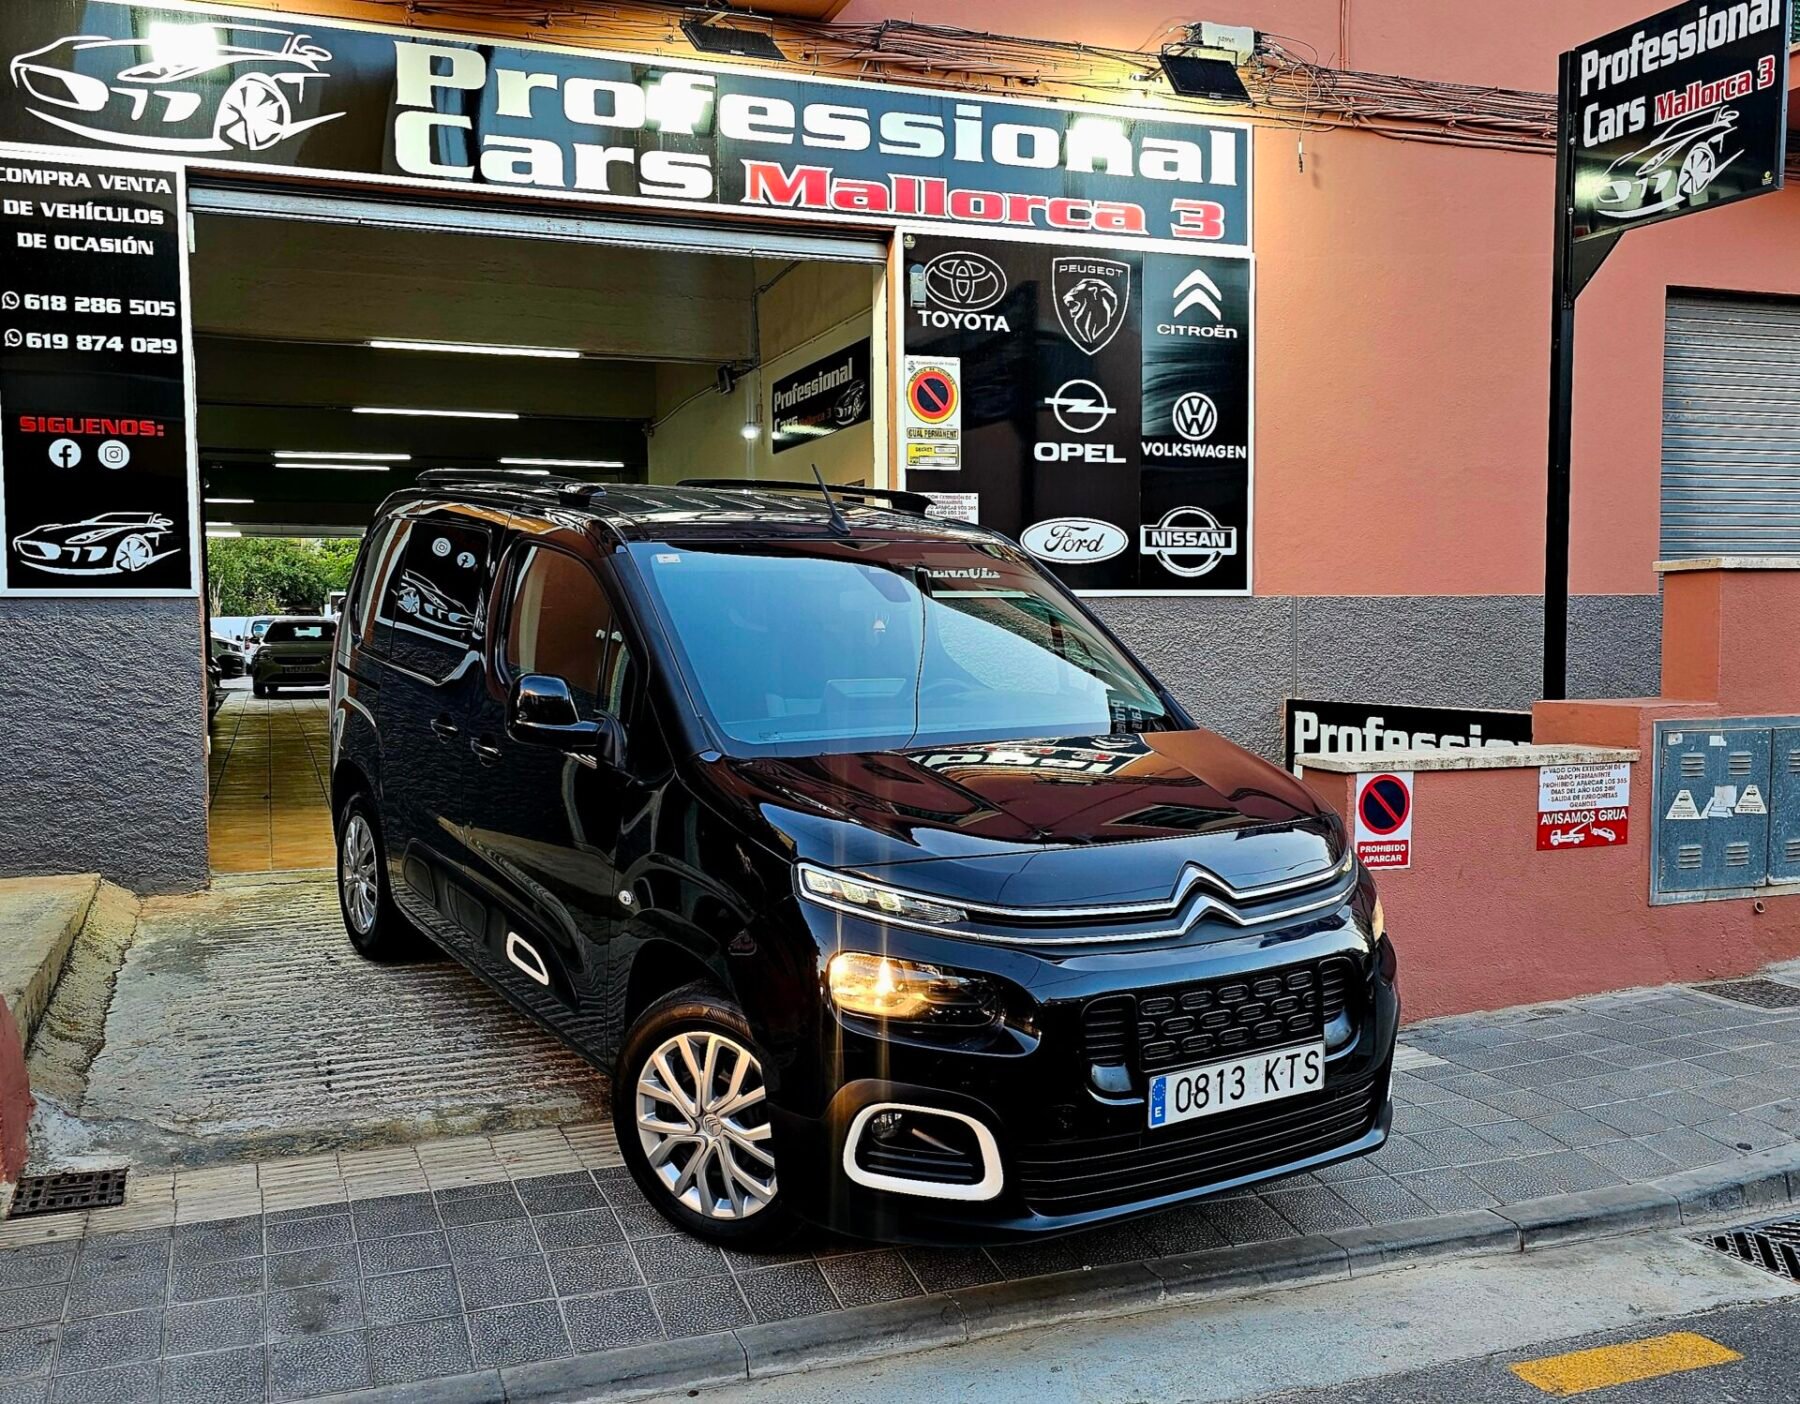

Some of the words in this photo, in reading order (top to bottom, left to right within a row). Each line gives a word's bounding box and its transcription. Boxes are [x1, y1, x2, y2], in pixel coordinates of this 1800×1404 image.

[1580, 0, 1780, 97] Professional
[1583, 96, 1646, 148] Cars
[1653, 69, 1752, 126] Mallorca
[1757, 54, 1776, 90] 3
[393, 40, 1239, 187] Professional
[98, 174, 172, 194] VENTA
[394, 110, 714, 200] Cars
[740, 158, 1150, 235] Mallorca
[1170, 197, 1225, 240] 3
[3, 199, 33, 216] DE
[40, 202, 164, 225] VEHÍCULOS
[17, 232, 47, 249] DE
[54, 235, 154, 255] OCASIÓN
[1059, 264, 1124, 278] PEUGEOT
[24, 294, 67, 311] 618
[74, 296, 122, 314] 286
[129, 299, 176, 316] 505
[917, 310, 1010, 333] TOYOTA
[26, 332, 69, 349] 619
[76, 335, 124, 351] 874
[131, 337, 178, 354] 029
[774, 357, 853, 413] Professional
[19, 415, 165, 437] SIGUENOS:
[1034, 441, 1127, 464] OPEL
[1142, 441, 1246, 459] VOLKSWAGEN
[1044, 526, 1104, 553] Ford
[1151, 531, 1226, 548] NISSAN
[1542, 781, 1574, 789] PROHIBIDO
[1575, 771, 1611, 779] PERMANENTE
[1581, 792, 1618, 800] FURGONETAS
[1540, 810, 1595, 825] AVISAMOS
[1598, 808, 1627, 821] GRUA
[1360, 844, 1406, 853] PROHIBIDO
[1363, 855, 1402, 863] APARCAR
[1175, 1065, 1245, 1113] 0813
[1264, 1050, 1319, 1094] KTS
[1155, 1106, 1162, 1117] E
